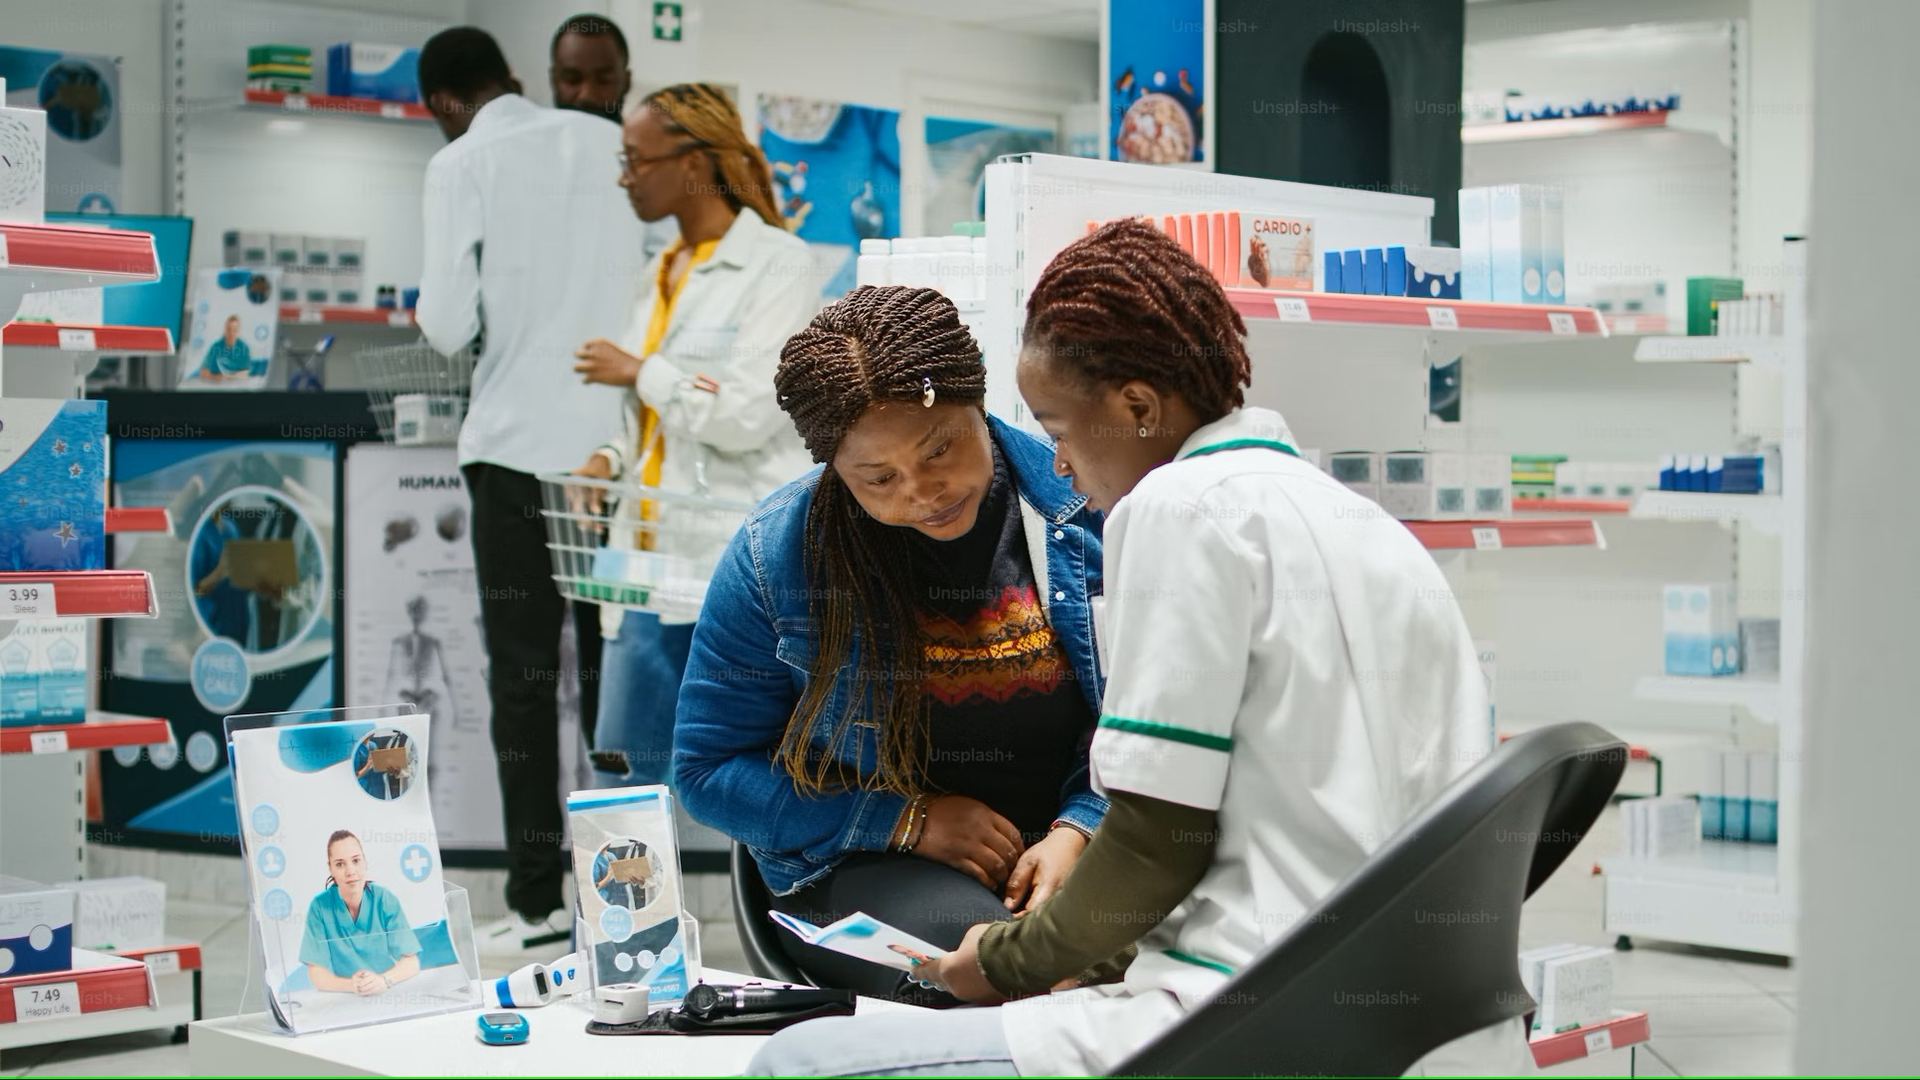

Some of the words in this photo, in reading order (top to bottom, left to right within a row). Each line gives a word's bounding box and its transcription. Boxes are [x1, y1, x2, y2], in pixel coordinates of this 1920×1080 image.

[1253, 219, 1301, 236] CARDIO
[1304, 224, 1313, 235] +
[398, 475, 462, 490] HUMAN
[9, 588, 39, 602] 3.99
[13, 604, 38, 614] Sleep
[31, 988, 61, 1003] 7.49
[24, 1006, 54, 1018] Happy
[54, 1003, 71, 1014] Life
